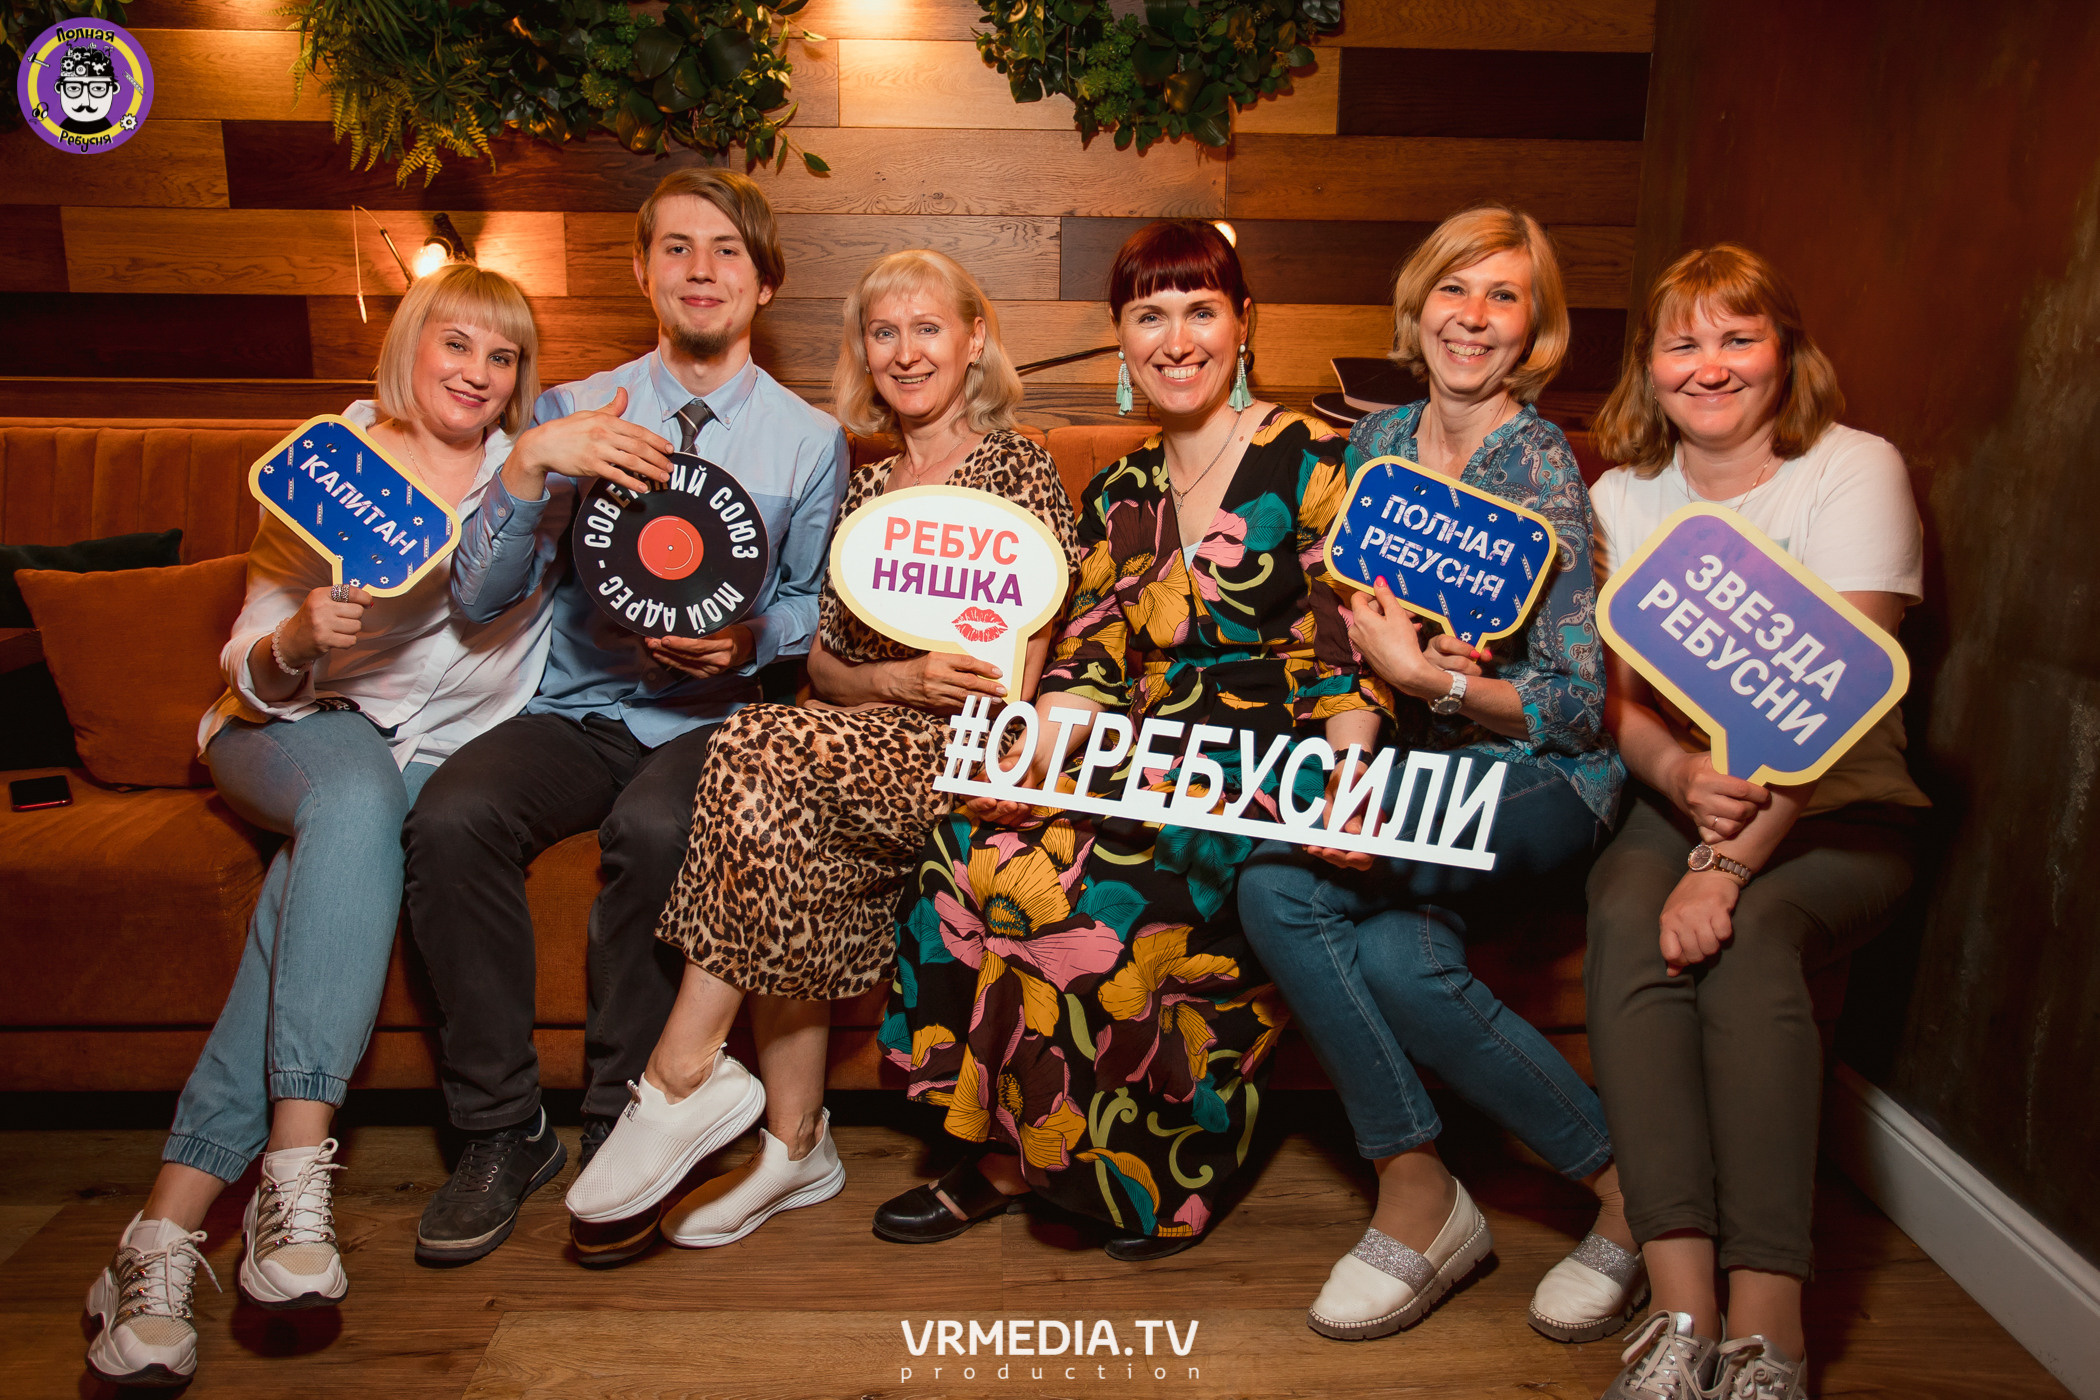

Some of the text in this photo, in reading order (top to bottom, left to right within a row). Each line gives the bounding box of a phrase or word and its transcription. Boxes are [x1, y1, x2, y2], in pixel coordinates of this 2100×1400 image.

[300, 454, 418, 556] КАПИТАН
[584, 463, 708, 549] СОВЕИЙ
[709, 486, 759, 559] СОЮЗ
[883, 516, 1020, 565] РЕБУС
[1380, 494, 1515, 567] ПОЛНАЯ
[872, 557, 1023, 606] НЯШКА
[1359, 525, 1506, 602] РЕБУСНЯ
[598, 575, 677, 632] АДРЕС
[686, 581, 745, 634] МОЙ
[1685, 554, 1847, 701] ЗВЕЗДА
[1636, 578, 1828, 746] РЕБУСНИ
[940, 694, 1508, 854] #ОТРЕБУСИЛИ
